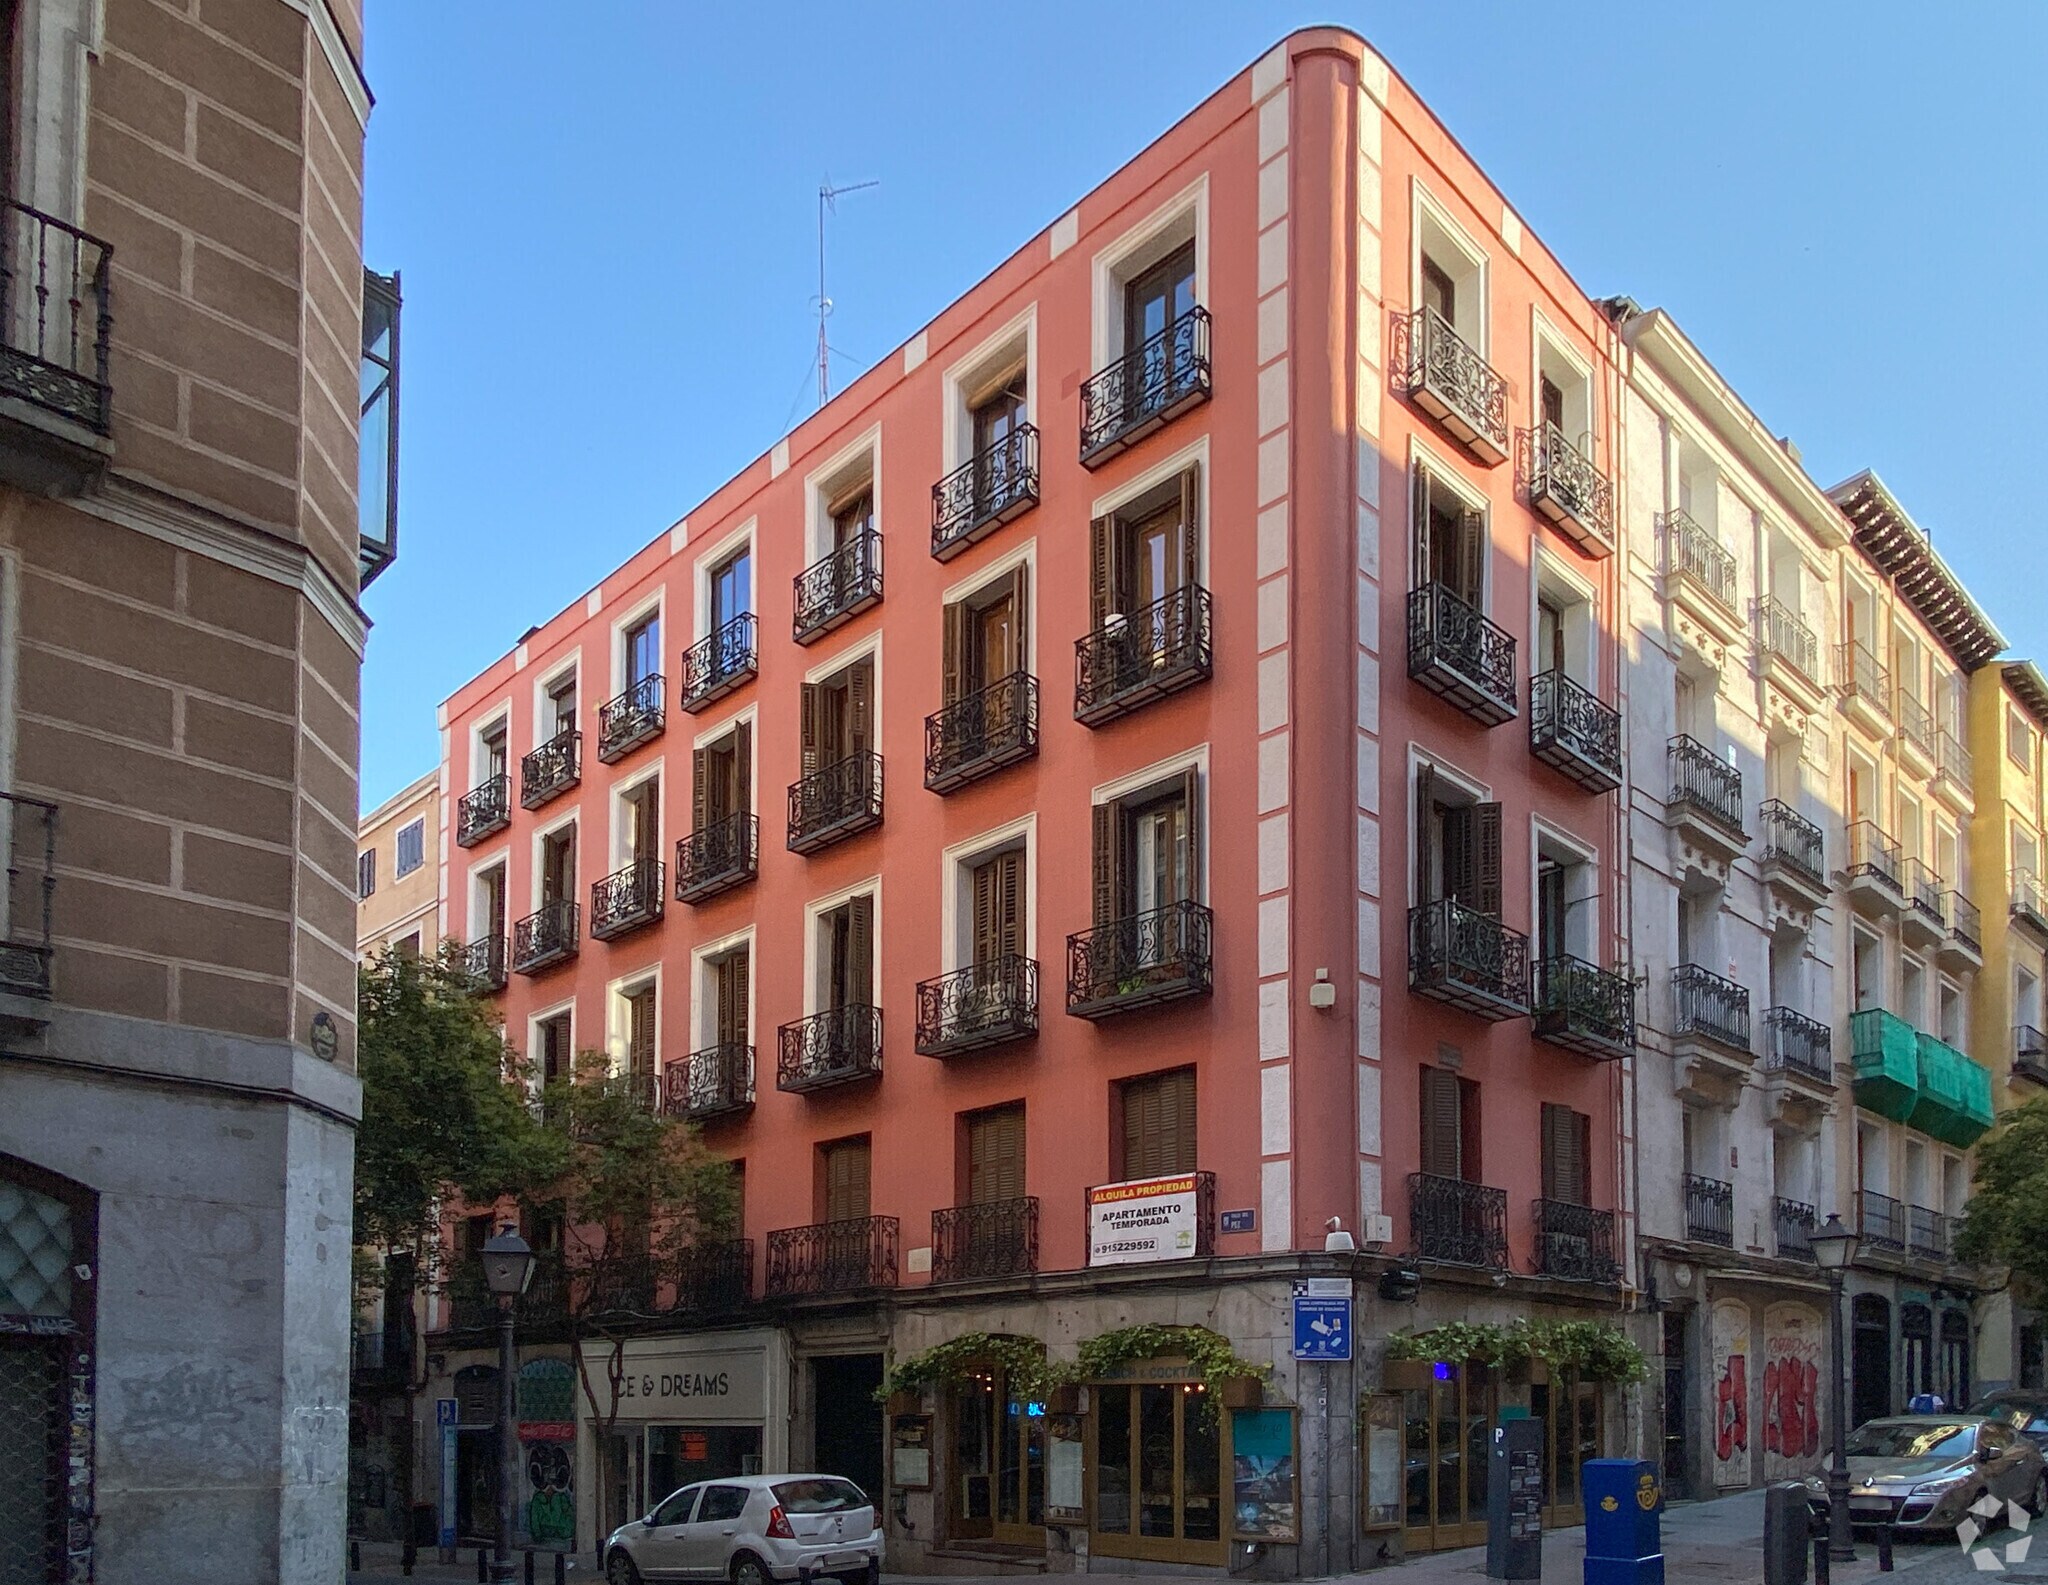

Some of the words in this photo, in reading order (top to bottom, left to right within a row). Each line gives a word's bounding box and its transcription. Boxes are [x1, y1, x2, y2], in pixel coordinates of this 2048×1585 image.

[1094, 1188, 1135, 1202] ALQUILA
[1136, 1181, 1193, 1196] PROPIEDAD
[1101, 1204, 1181, 1222] APARTAMENTO
[1111, 1216, 1170, 1230] TEMPORADA
[1101, 1240, 1155, 1254] 915229592
[642, 1374, 655, 1397] &
[661, 1372, 729, 1397] DREAMS
[1495, 1428, 1504, 1443] P
